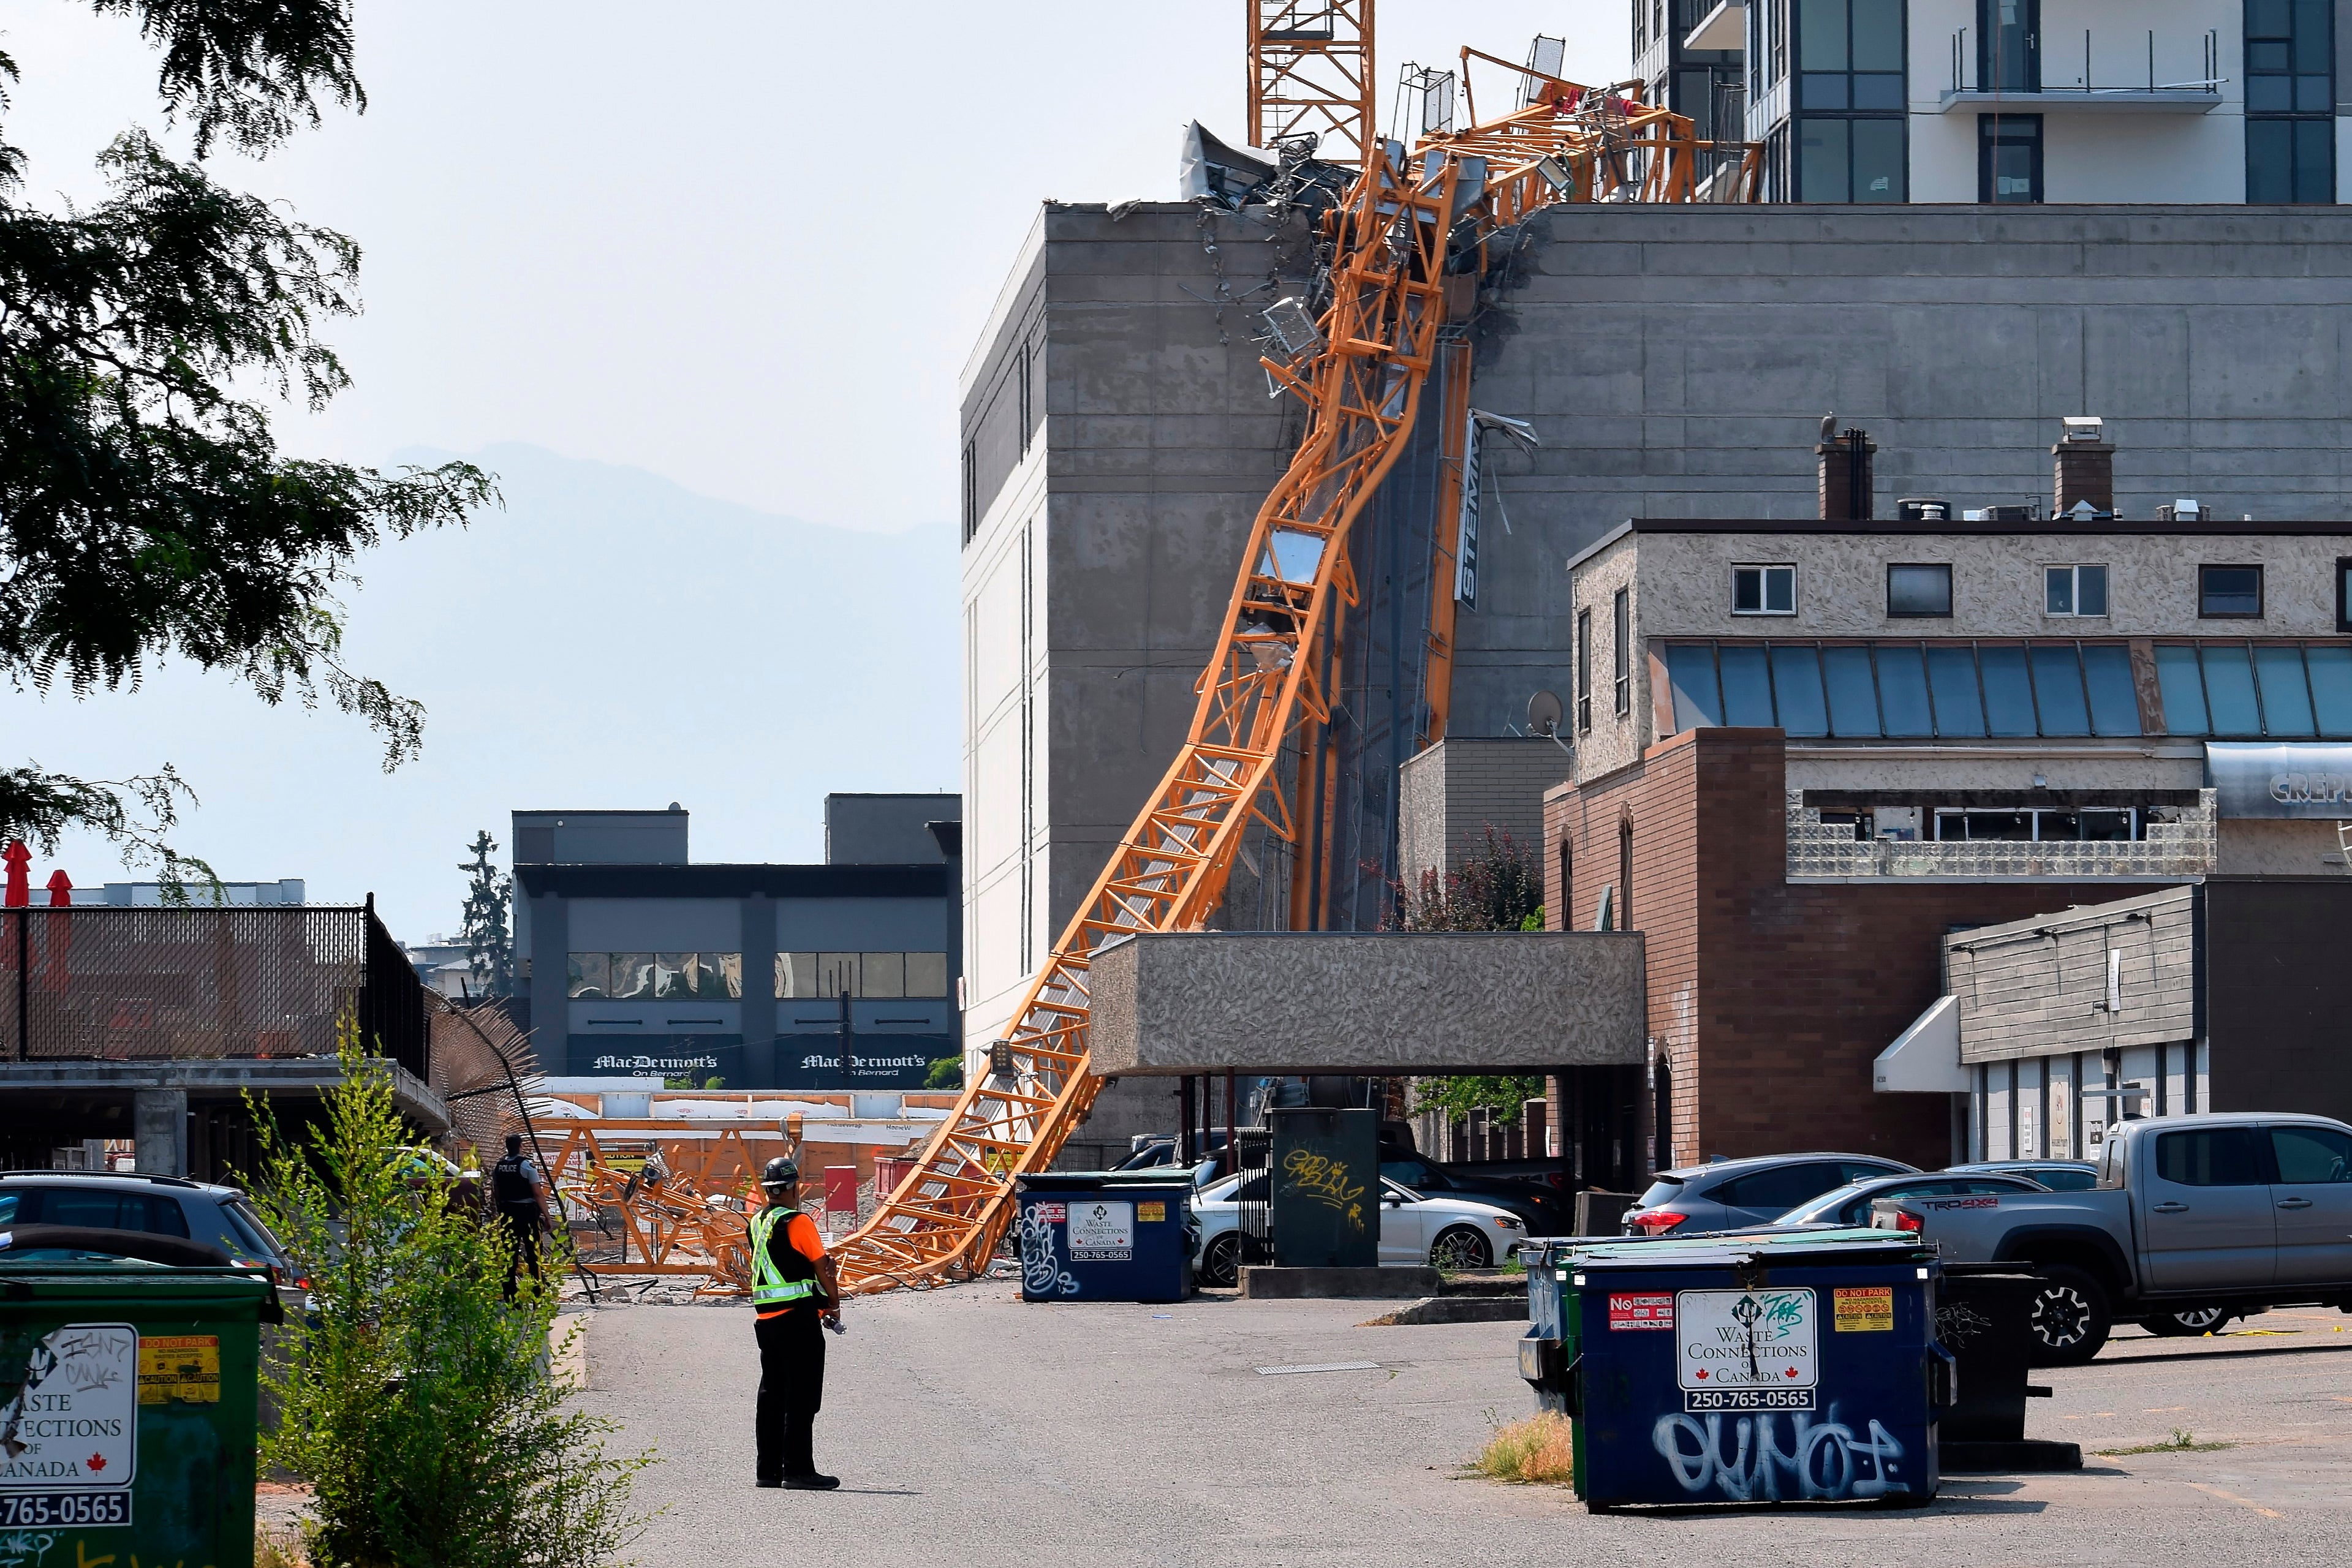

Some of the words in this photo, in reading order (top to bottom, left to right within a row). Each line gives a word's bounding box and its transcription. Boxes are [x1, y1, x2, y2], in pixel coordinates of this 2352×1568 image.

[593, 1055, 717, 1069] MacDermott's
[1921, 1200, 1961, 1211] TRD
[1085, 1238, 1116, 1246] CANADA
[1715, 1327, 1774, 1342] WASTE
[163, 1338, 182, 1347] NOT
[186, 1338, 211, 1346] PARK
[1692, 1392, 1808, 1408] 250-765-0565
[0, 1419, 121, 1437] ECTIONS
[0, 1461, 80, 1477] ANADA
